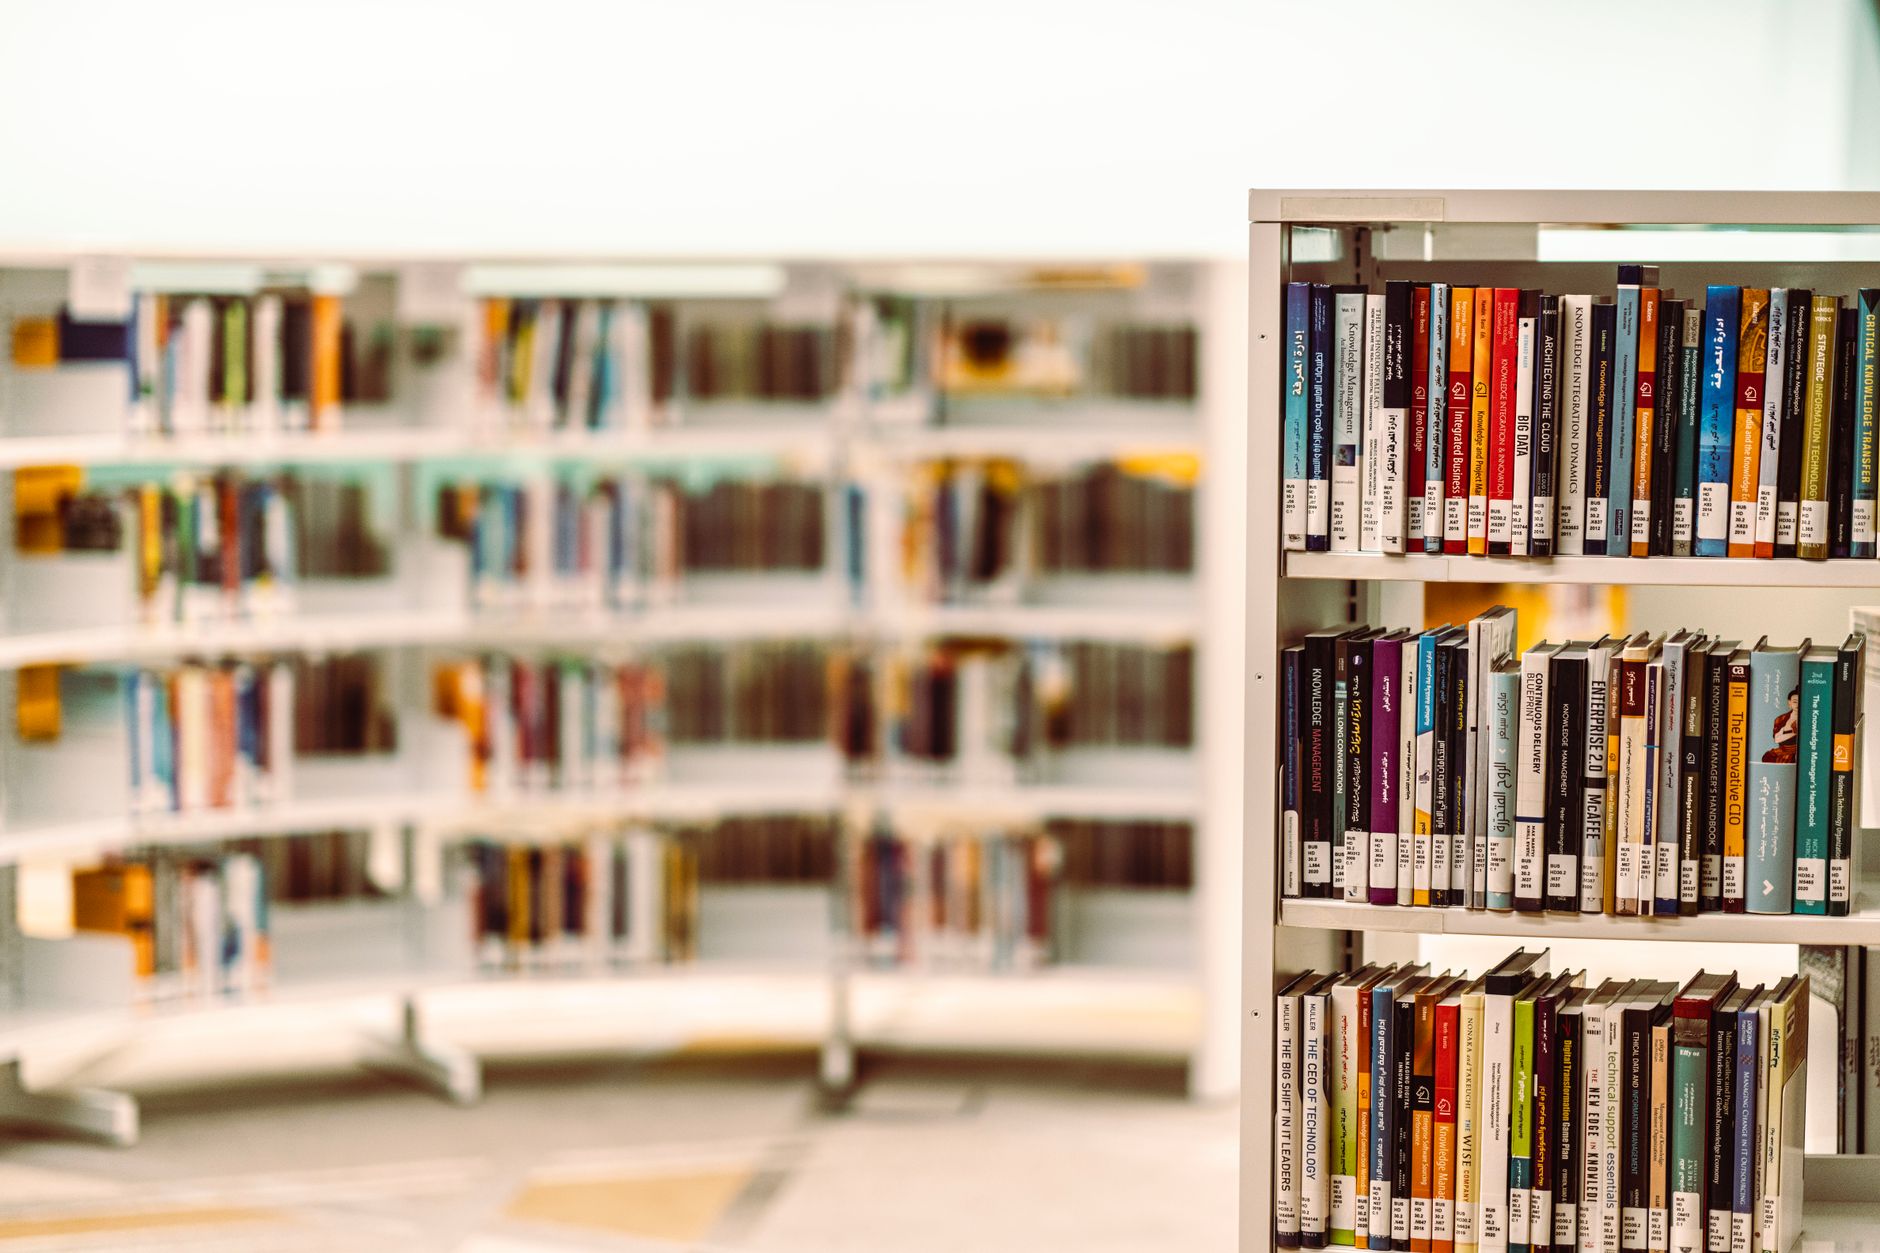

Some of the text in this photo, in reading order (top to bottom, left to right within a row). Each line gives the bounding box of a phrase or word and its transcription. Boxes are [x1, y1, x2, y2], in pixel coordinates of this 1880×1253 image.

[1690, 316, 1698, 343] palgrave
[1797, 306, 1805, 337] Knowledge
[1865, 314, 1876, 361] CRITICAL
[1292, 330, 1305, 395] إدارة المعرفة
[1712, 346, 1724, 389] المعرفة
[1794, 338, 1803, 363] Economy
[1345, 323, 1358, 434] Knowledge Management
[1373, 376, 1381, 411] FALLACY
[1499, 359, 1508, 401] KNOWLEDGE
[1541, 335, 1554, 453] ARCHITECTING THE CLOUD
[1688, 350, 1699, 426] Autopoietic Knowledge Systems
[1794, 371, 1802, 379] the
[1862, 364, 1874, 427] KNOWLEDGE
[1569, 307, 1584, 495] KNOWLEDGE INTEGRATION DYNAMICS
[1792, 380, 1801, 415] Megalopolis
[1808, 334, 1827, 501] STRATEGIC INFORMATION TECHNOLOGY
[1413, 411, 1425, 452] Zero Outage
[1498, 401, 1507, 446] INTEGRATION
[1516, 415, 1529, 457] BIG DATA
[1595, 360, 1608, 498] Knowledge Management Handbo
[1451, 411, 1465, 495] Integrated Business
[1473, 411, 1485, 483] Knowledge and Project
[1740, 413, 1755, 493] India and the Knowledge
[1861, 430, 1872, 484] TRANSFER
[1497, 454, 1506, 497] INNOVATION
[1496, 693, 1510, 740] مايكل سينغر
[1525, 672, 1534, 722] BLUEPRINT
[1311, 668, 1322, 794] KNOWLEDGE MANAGEMENT
[1532, 672, 1543, 774] CONTINUOUS DELIVERY
[1588, 680, 1606, 772] ENTERPRISE 2.0
[1732, 712, 1744, 734] The
[1810, 709, 1819, 750] Knowledge
[1336, 702, 1345, 794] THE LONG CONVERSATION
[1560, 703, 1570, 797] KNOWLEDGE MANAGEMENT
[1707, 667, 1721, 846] THE KNOWLEDGE MANAGER'S HANDBOOK
[1730, 736, 1743, 802] Innovative
[1493, 762, 1512, 788] الروح
[1808, 751, 1818, 789] Manager's
[1686, 777, 1694, 808] Knowledge
[1808, 790, 1817, 828] Handbook
[1586, 794, 1603, 840] McAFEE
[1728, 803, 1741, 826] CIO
[1282, 1038, 1291, 1057] THE
[1308, 1038, 1317, 1060] THE
[1466, 1017, 1474, 1053] NONAKA
[1745, 1019, 1754, 1046] palgrave
[1282, 1062, 1291, 1079] BIG
[1307, 1063, 1317, 1085] CEO
[1464, 1068, 1472, 1110] TAKEUCHI
[1282, 1082, 1291, 1113] SHIFT
[1307, 1088, 1317, 1102] OF
[1403, 1085, 1411, 1110] DIGITAL
[1561, 1039, 1572, 1160] Digital Transformation Game Plan
[1588, 1087, 1600, 1107] NEW
[1630, 1031, 1640, 1175] ETHICAL DATA AND INFORMATION MANAGEMENT
[1282, 1116, 1291, 1127] IN
[1282, 1130, 1291, 1140] IT
[1422, 1114, 1430, 1139] Enterprise
[1587, 1112, 1599, 1137] EDGE
[1605, 1051, 1619, 1208] technical support essentials
[1713, 1118, 1722, 1154] Knowledge
[1306, 1105, 1317, 1181] TECHNOLOGY
[1435, 1125, 1449, 1200] Knowledge Manag
[1462, 1134, 1472, 1167] WISE
[1589, 1141, 1597, 1150] IN
[1282, 1142, 1291, 1192] LEADERS
[1420, 1163, 1429, 1185] Sourcing
[1462, 1169, 1470, 1202] COMPANY
[1586, 1152, 1598, 1202] KNOWLED
[1712, 1155, 1720, 1184] Economy
